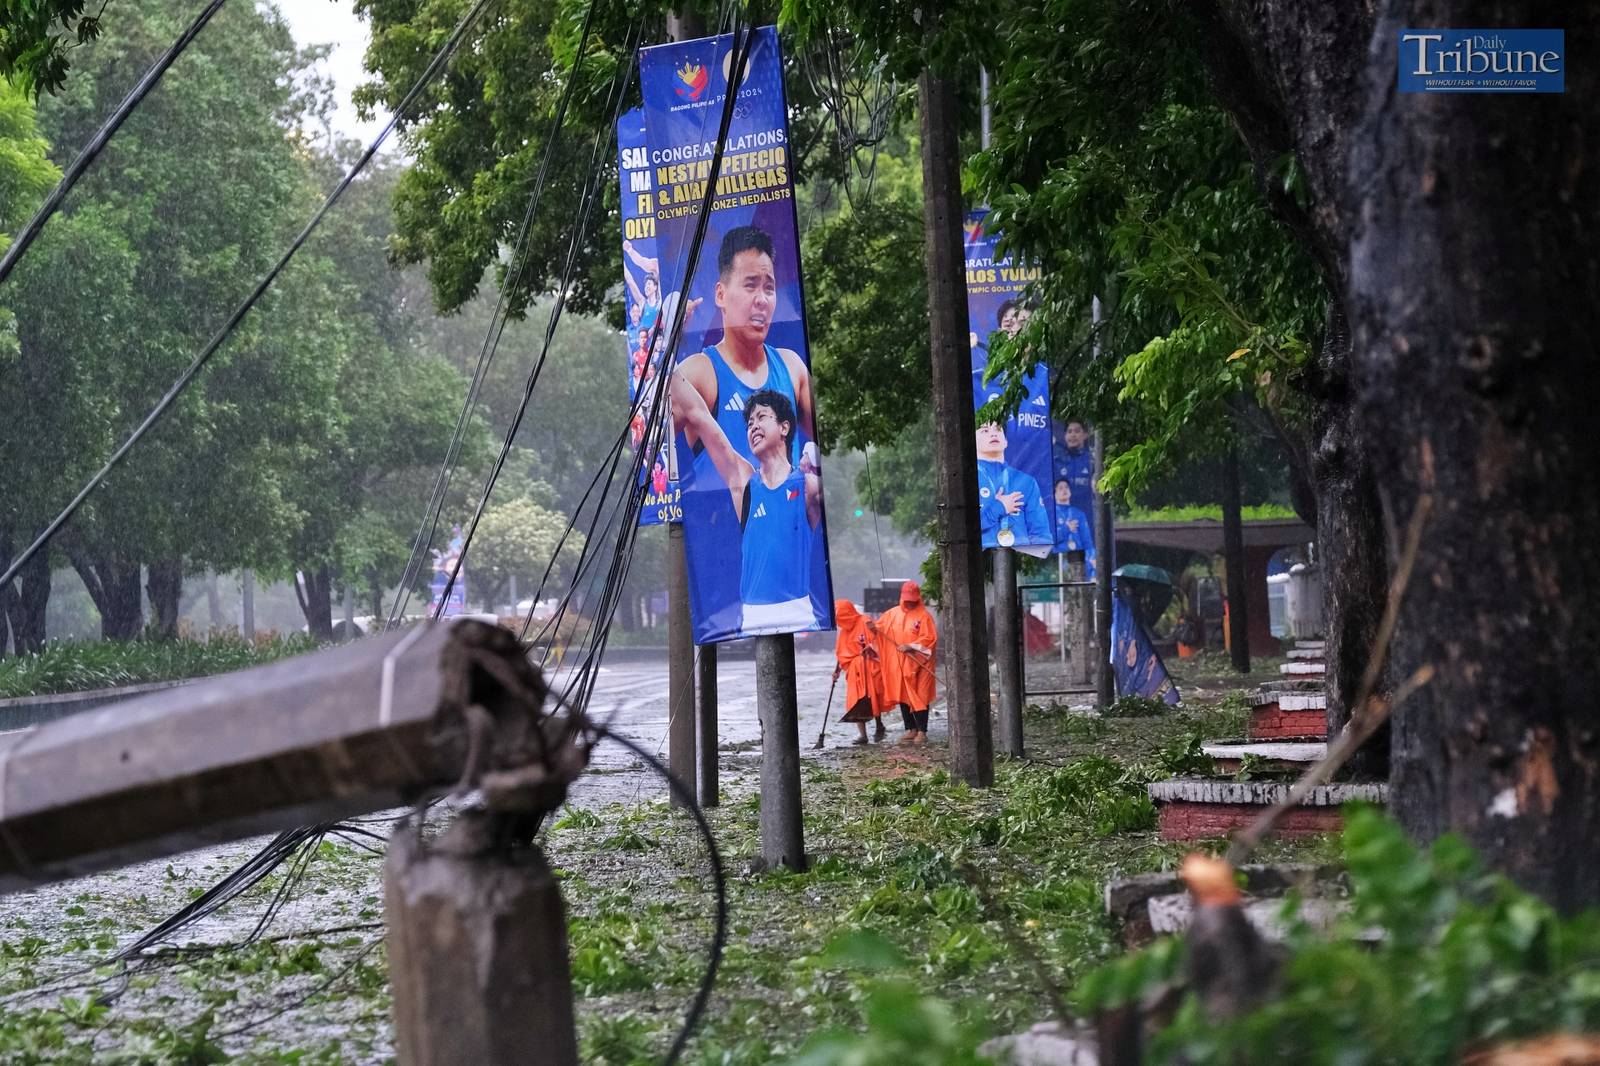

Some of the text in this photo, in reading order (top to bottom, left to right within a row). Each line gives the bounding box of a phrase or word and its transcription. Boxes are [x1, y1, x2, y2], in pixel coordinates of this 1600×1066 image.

[721, 146, 786, 175] PETECIO
[658, 190, 671, 206] &
[715, 166, 788, 196] VILLEGAS
[638, 193, 654, 215] FI
[657, 204, 698, 220] OLYMPIC
[740, 188, 791, 206] MEDALISTS
